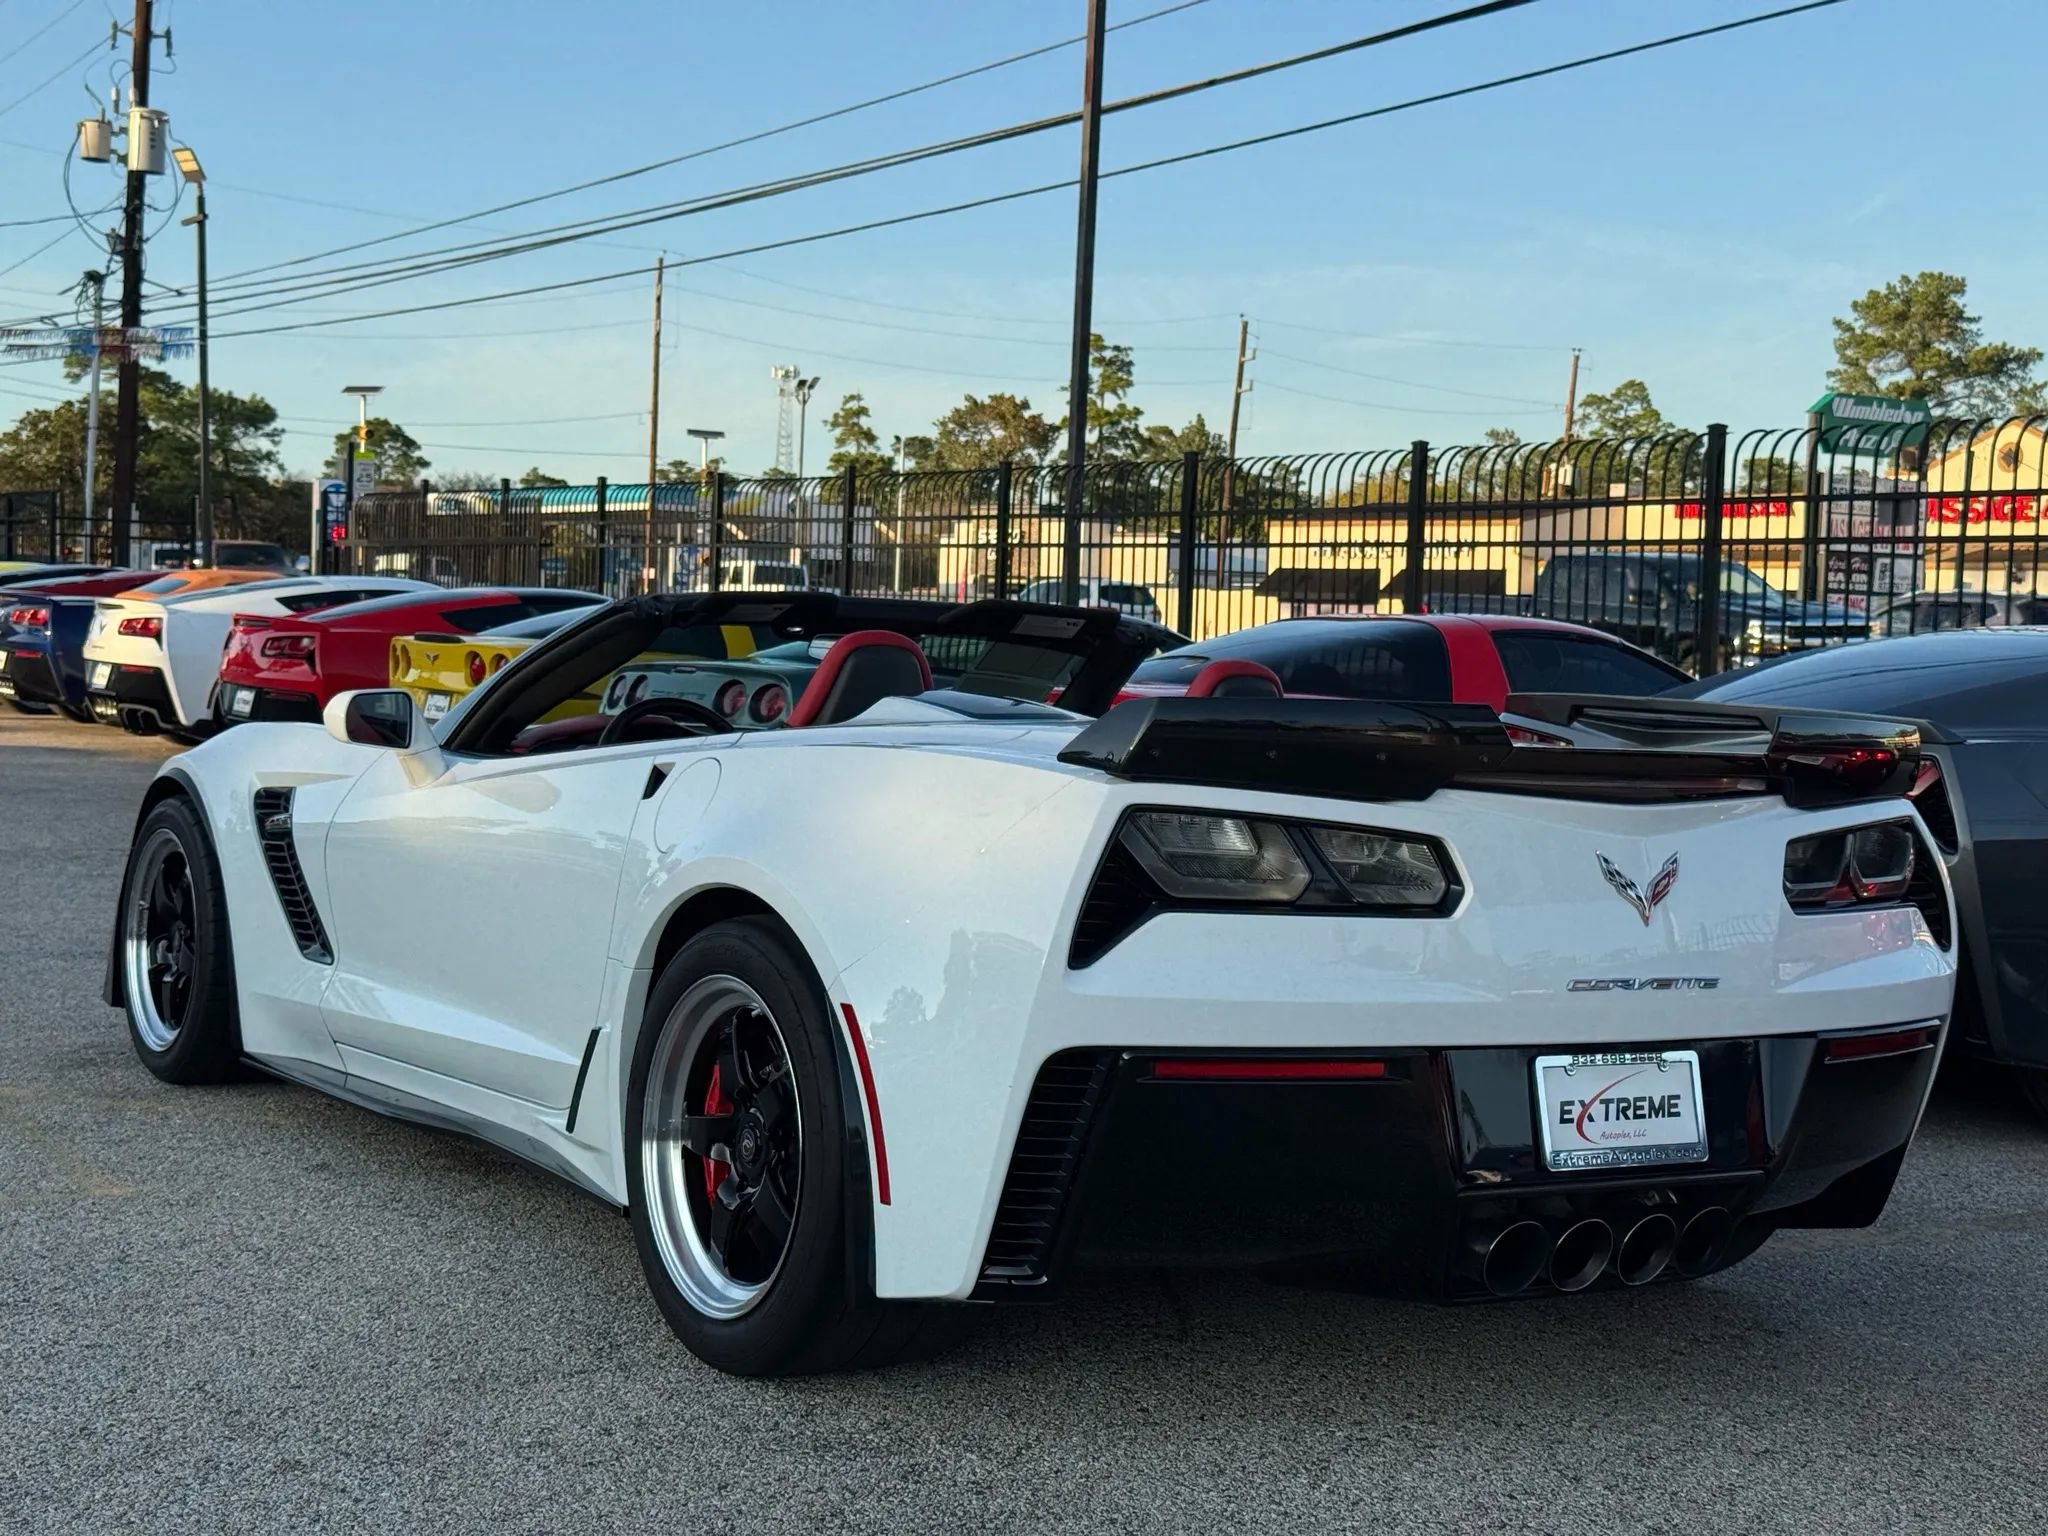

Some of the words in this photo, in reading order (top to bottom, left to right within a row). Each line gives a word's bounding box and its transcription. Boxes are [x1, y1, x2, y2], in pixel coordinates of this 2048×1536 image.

[1832, 397, 1925, 424] Wimbledon
[1566, 978, 1720, 992] CORVETTE
[1559, 1094, 1681, 1125] EXTREME
[1633, 1129, 1648, 1138] LLC
